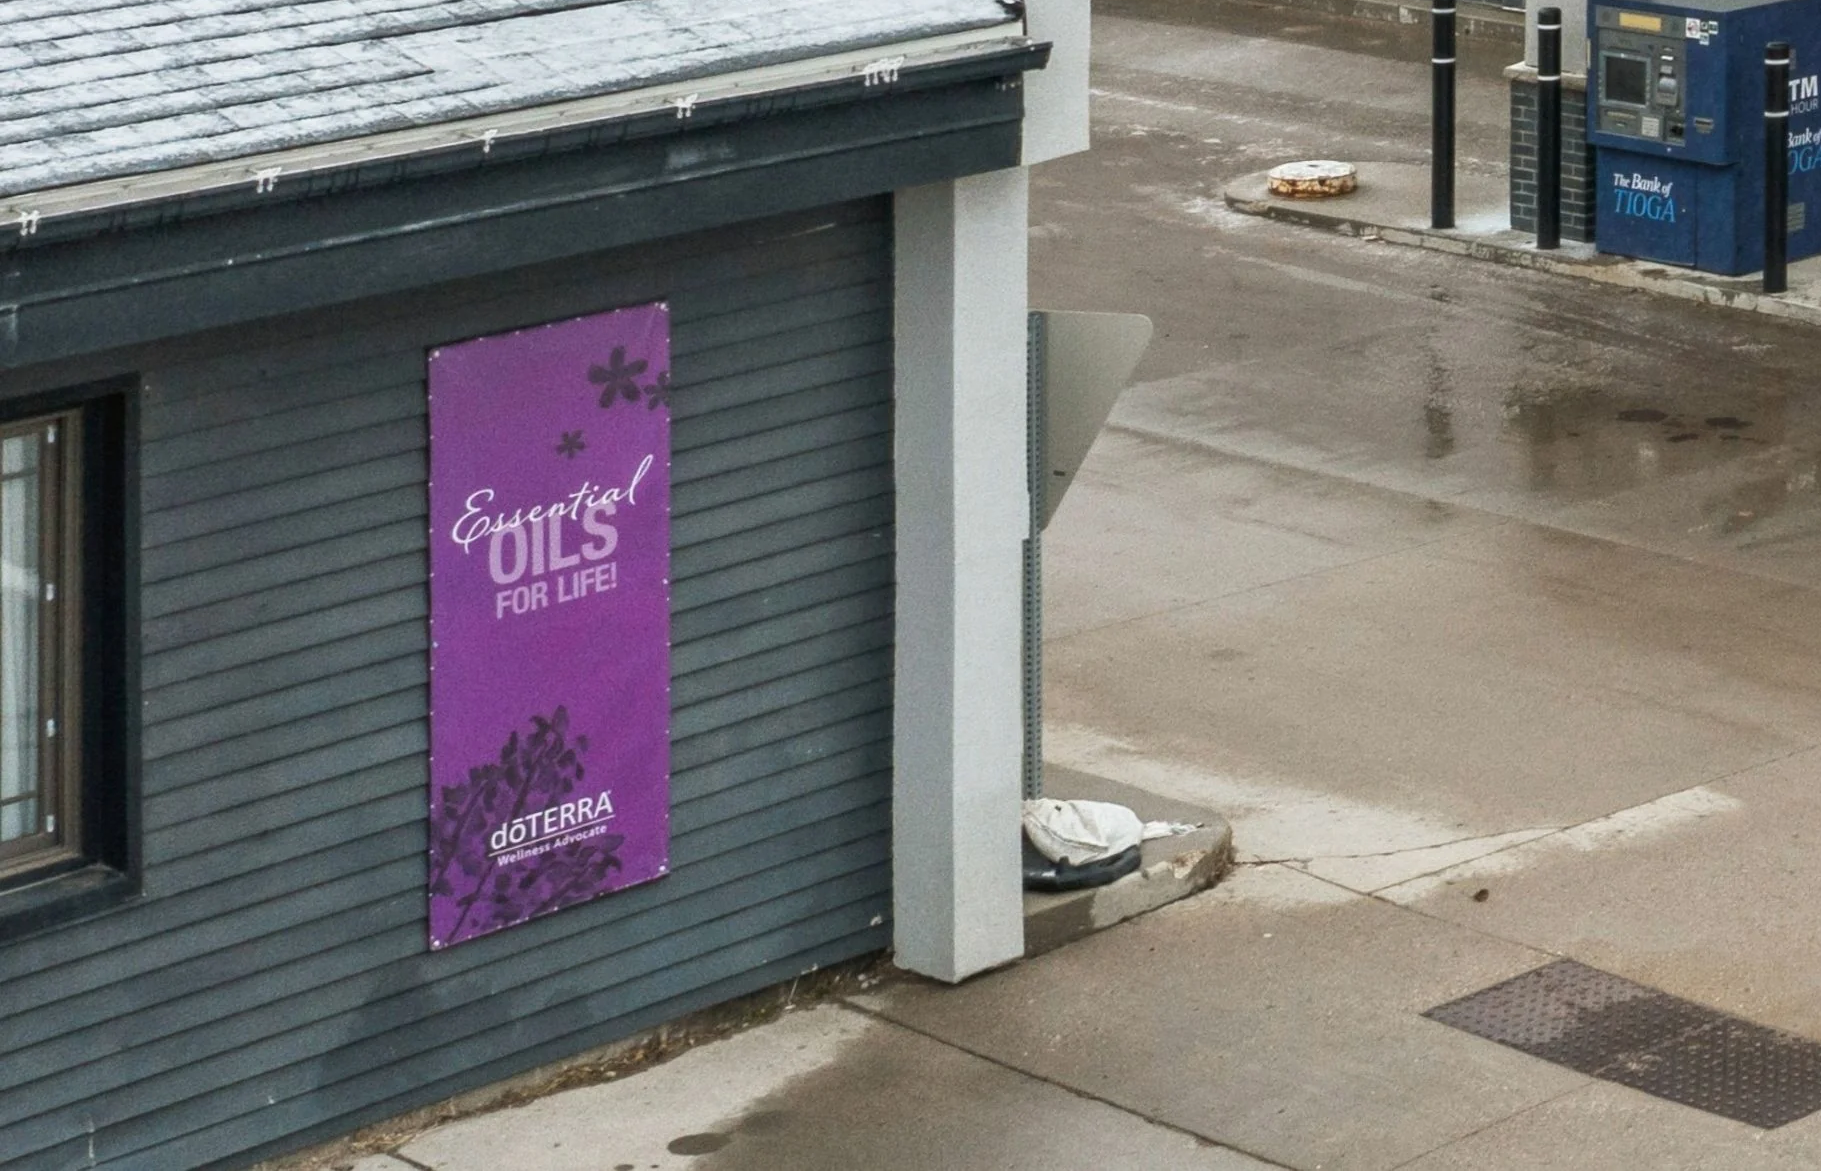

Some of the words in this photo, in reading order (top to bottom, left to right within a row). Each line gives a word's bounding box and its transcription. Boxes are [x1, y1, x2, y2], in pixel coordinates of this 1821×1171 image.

[1788, 75, 1818, 102] TM
[1613, 173, 1631, 188] The
[1631, 173, 1662, 193] Bank
[1661, 182, 1673, 198] of
[1614, 189, 1676, 223] TIOGA
[452, 454, 654, 554] Essential
[489, 501, 618, 584] OILS
[496, 581, 549, 619] FOR
[558, 561, 618, 603] LIFE!
[490, 790, 613, 850] dōTERRA
[497, 842, 551, 867] Wellness
[553, 825, 607, 848] Advocate
